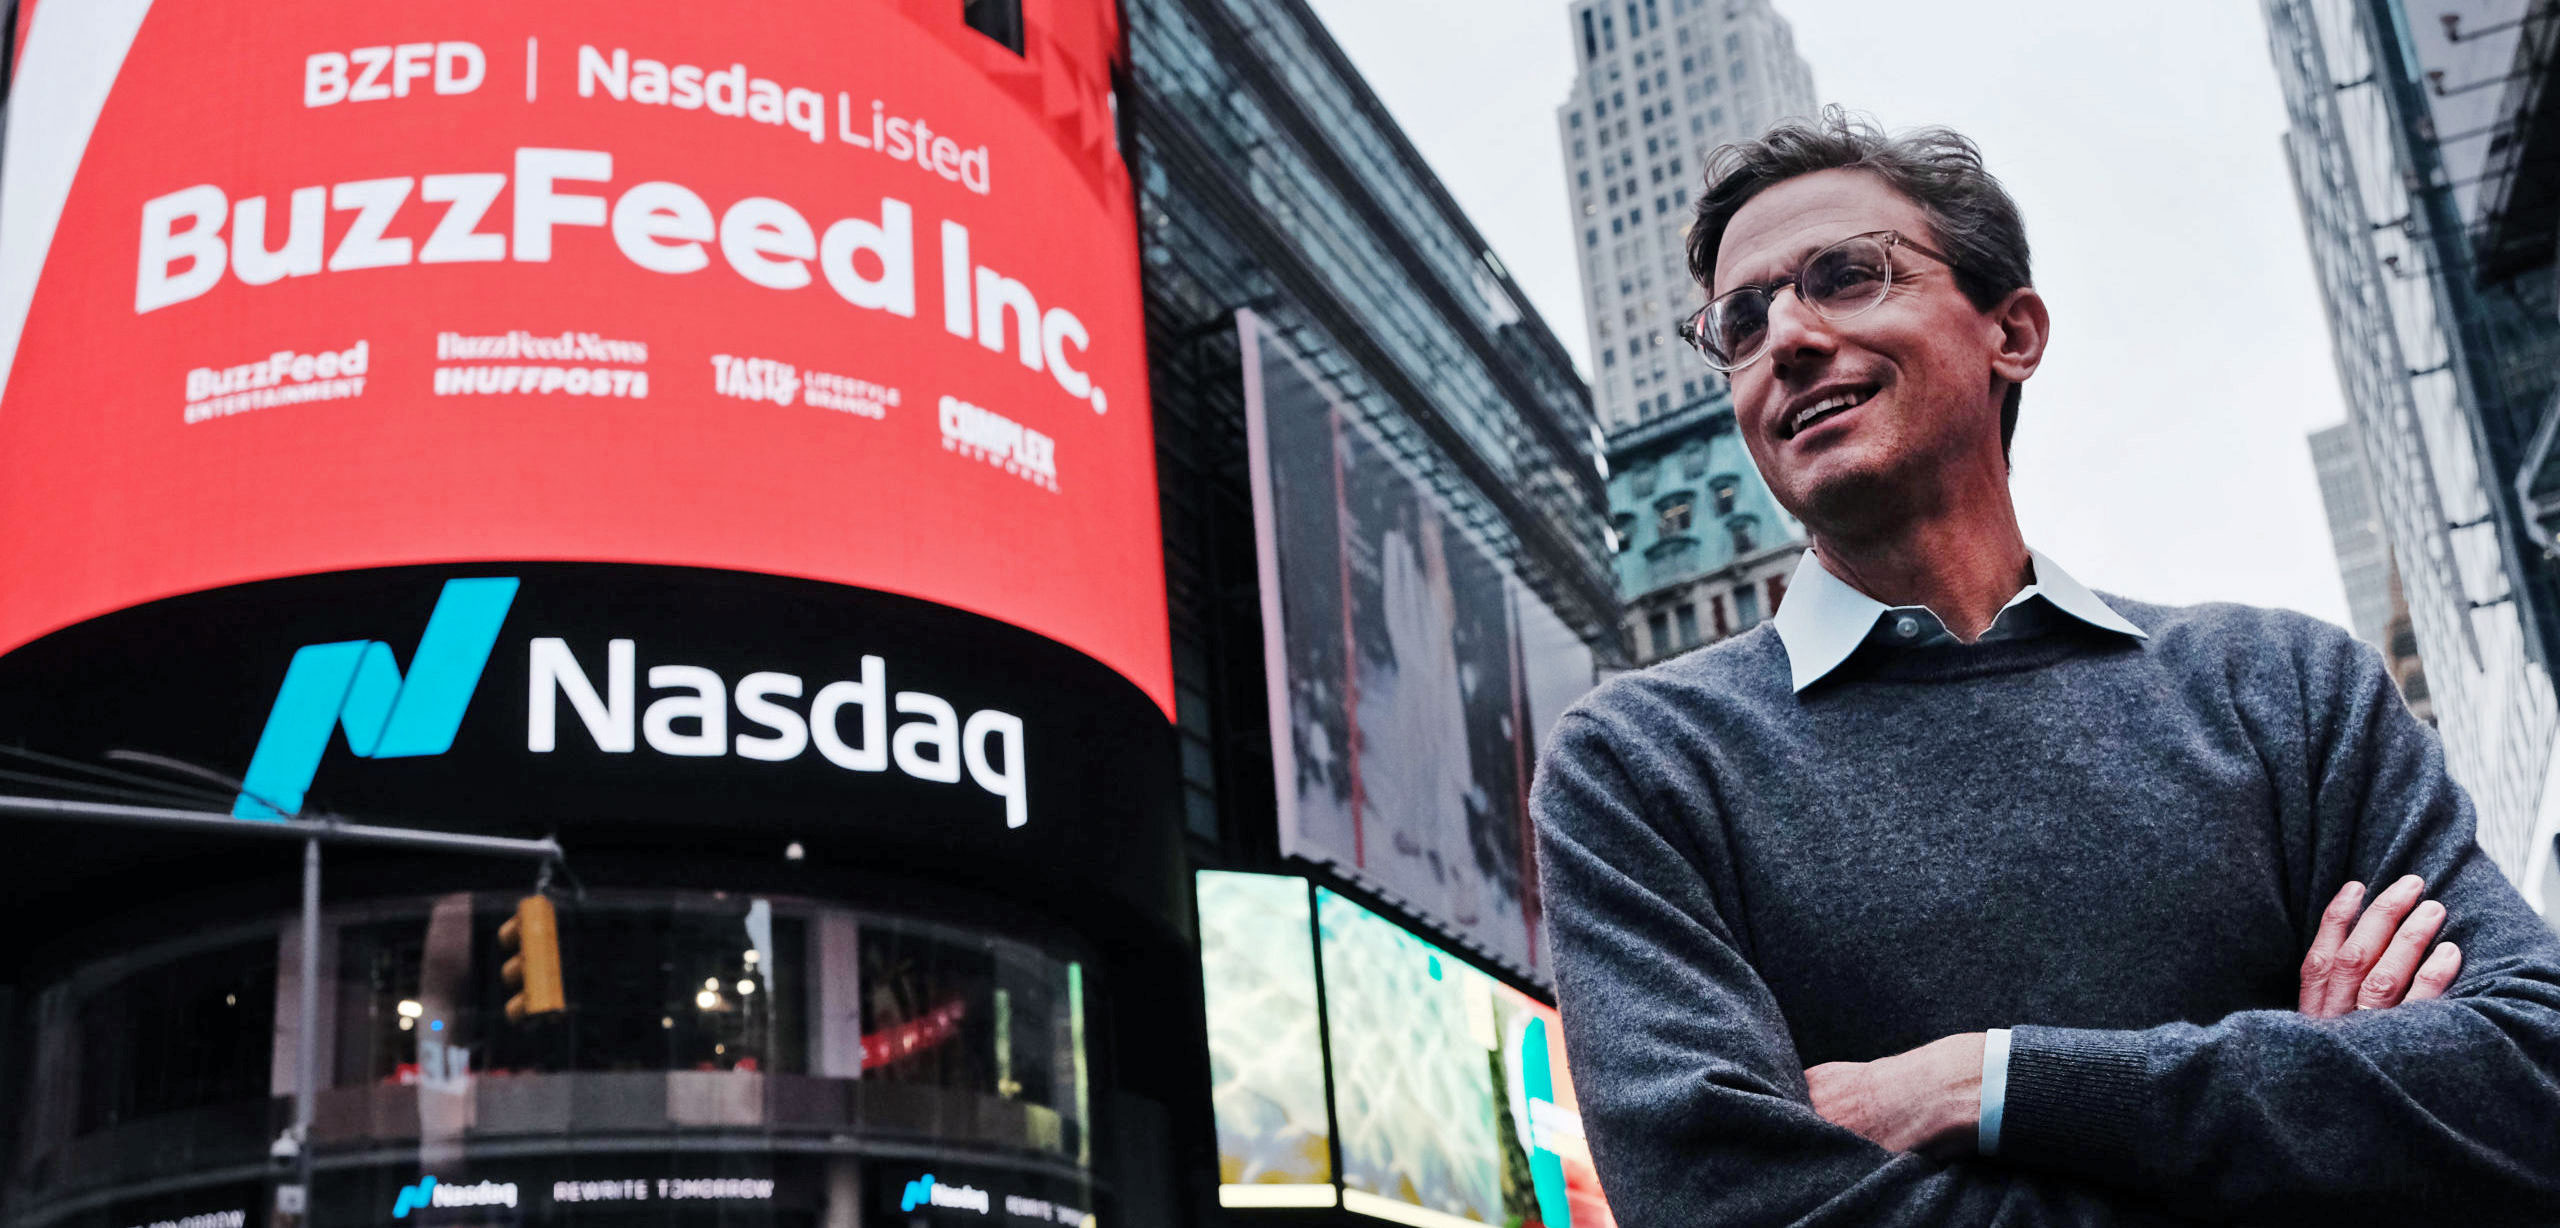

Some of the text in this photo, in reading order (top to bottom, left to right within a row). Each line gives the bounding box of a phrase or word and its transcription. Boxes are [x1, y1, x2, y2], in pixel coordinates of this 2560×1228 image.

[304, 41, 990, 195] BZFD Nasdaq Listed
[135, 146, 1108, 415] BuzzFeed Inc.
[184, 376, 367, 424] ENTERTAINMENT
[186, 340, 369, 402] BuzzFeed
[938, 395, 1056, 475] COMPLEX
[527, 637, 1028, 829] Nasdaq
[432, 1180, 518, 1209] Nasdaq
